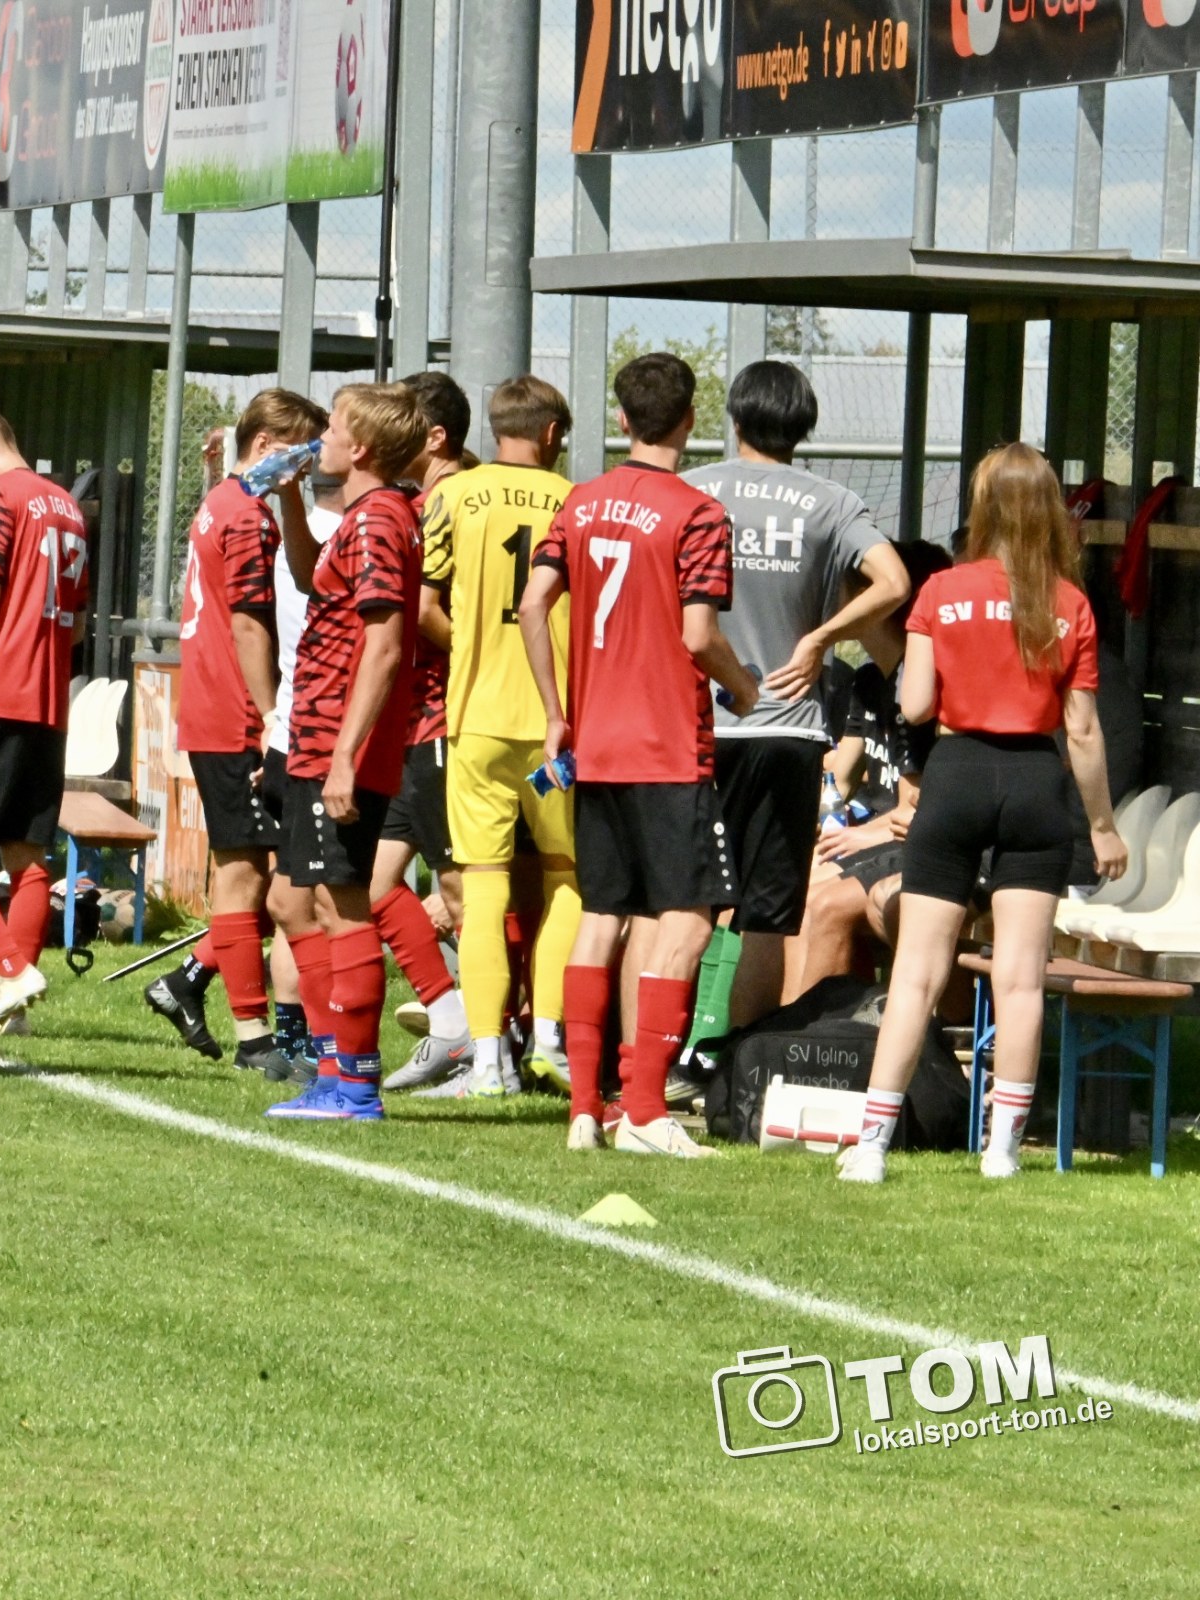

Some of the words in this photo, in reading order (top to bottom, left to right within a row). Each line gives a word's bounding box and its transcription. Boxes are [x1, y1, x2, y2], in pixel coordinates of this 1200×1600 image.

[80, 4, 144, 87] Hauptsponsor
[736, 31, 809, 101] www.netgo.de
[502, 488, 564, 513] IGLIN
[735, 481, 816, 510] IGLING
[601, 499, 661, 534] IGLING
[589, 536, 632, 649] 7
[938, 601, 973, 624] SV
[786, 1044, 810, 1062] SV
[817, 1045, 859, 1068] Igling
